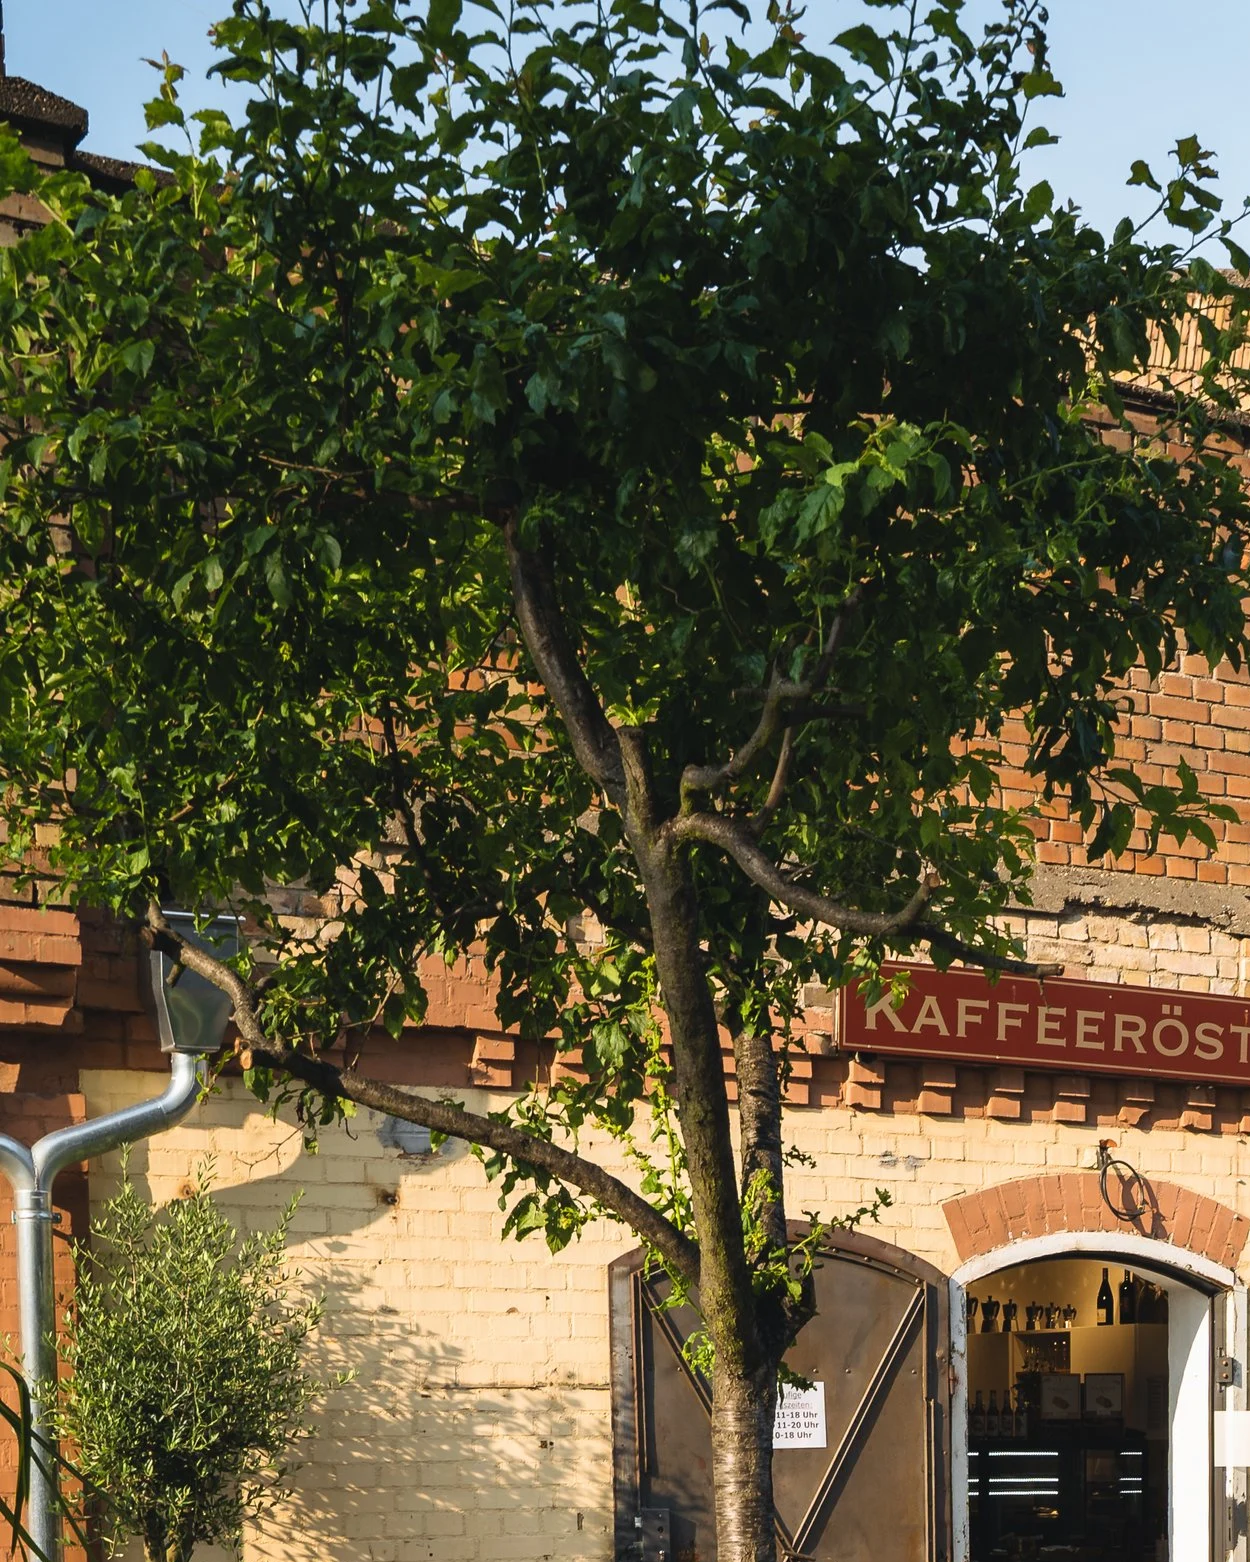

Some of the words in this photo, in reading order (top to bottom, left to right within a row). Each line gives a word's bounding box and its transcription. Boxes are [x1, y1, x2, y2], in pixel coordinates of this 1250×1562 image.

[776, 1411, 800, 1419] 11-18
[803, 1411, 818, 1419] Uhr
[777, 1421, 801, 1429] 11-20
[804, 1421, 819, 1429] Uhr
[774, 1431, 794, 1439] 0-18
[797, 1431, 812, 1439] Uhr
